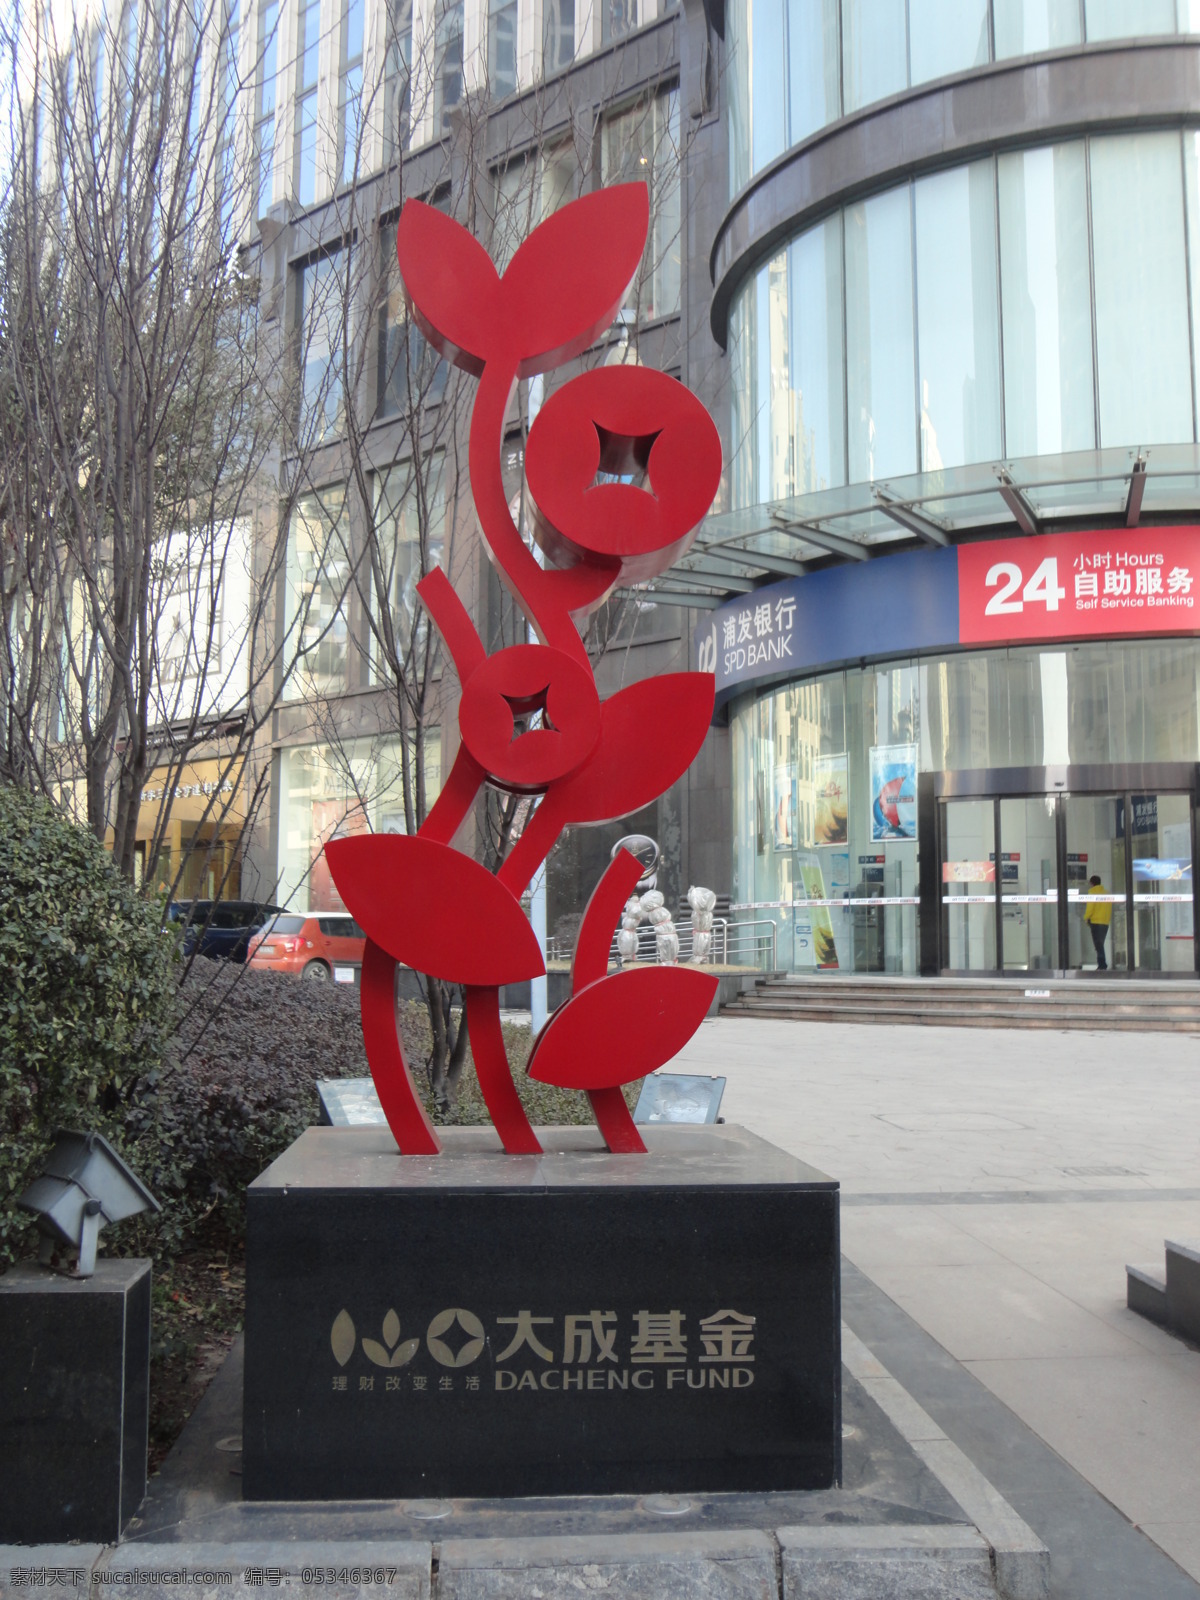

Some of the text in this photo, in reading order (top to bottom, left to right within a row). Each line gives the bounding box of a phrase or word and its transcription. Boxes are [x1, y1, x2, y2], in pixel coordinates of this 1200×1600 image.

[1073, 551, 1164, 570] 小时 Hours
[985, 557, 1065, 616] 24
[1074, 566, 1193, 598] 自助服务
[1076, 595, 1194, 610] Self Service Banking
[723, 597, 797, 650] 浦发银行
[724, 633, 793, 675] SPD BANK
[495, 1309, 756, 1364] 大成基金
[332, 1375, 480, 1391] 理财改变生活
[495, 1368, 755, 1391] DACHENG FUND
